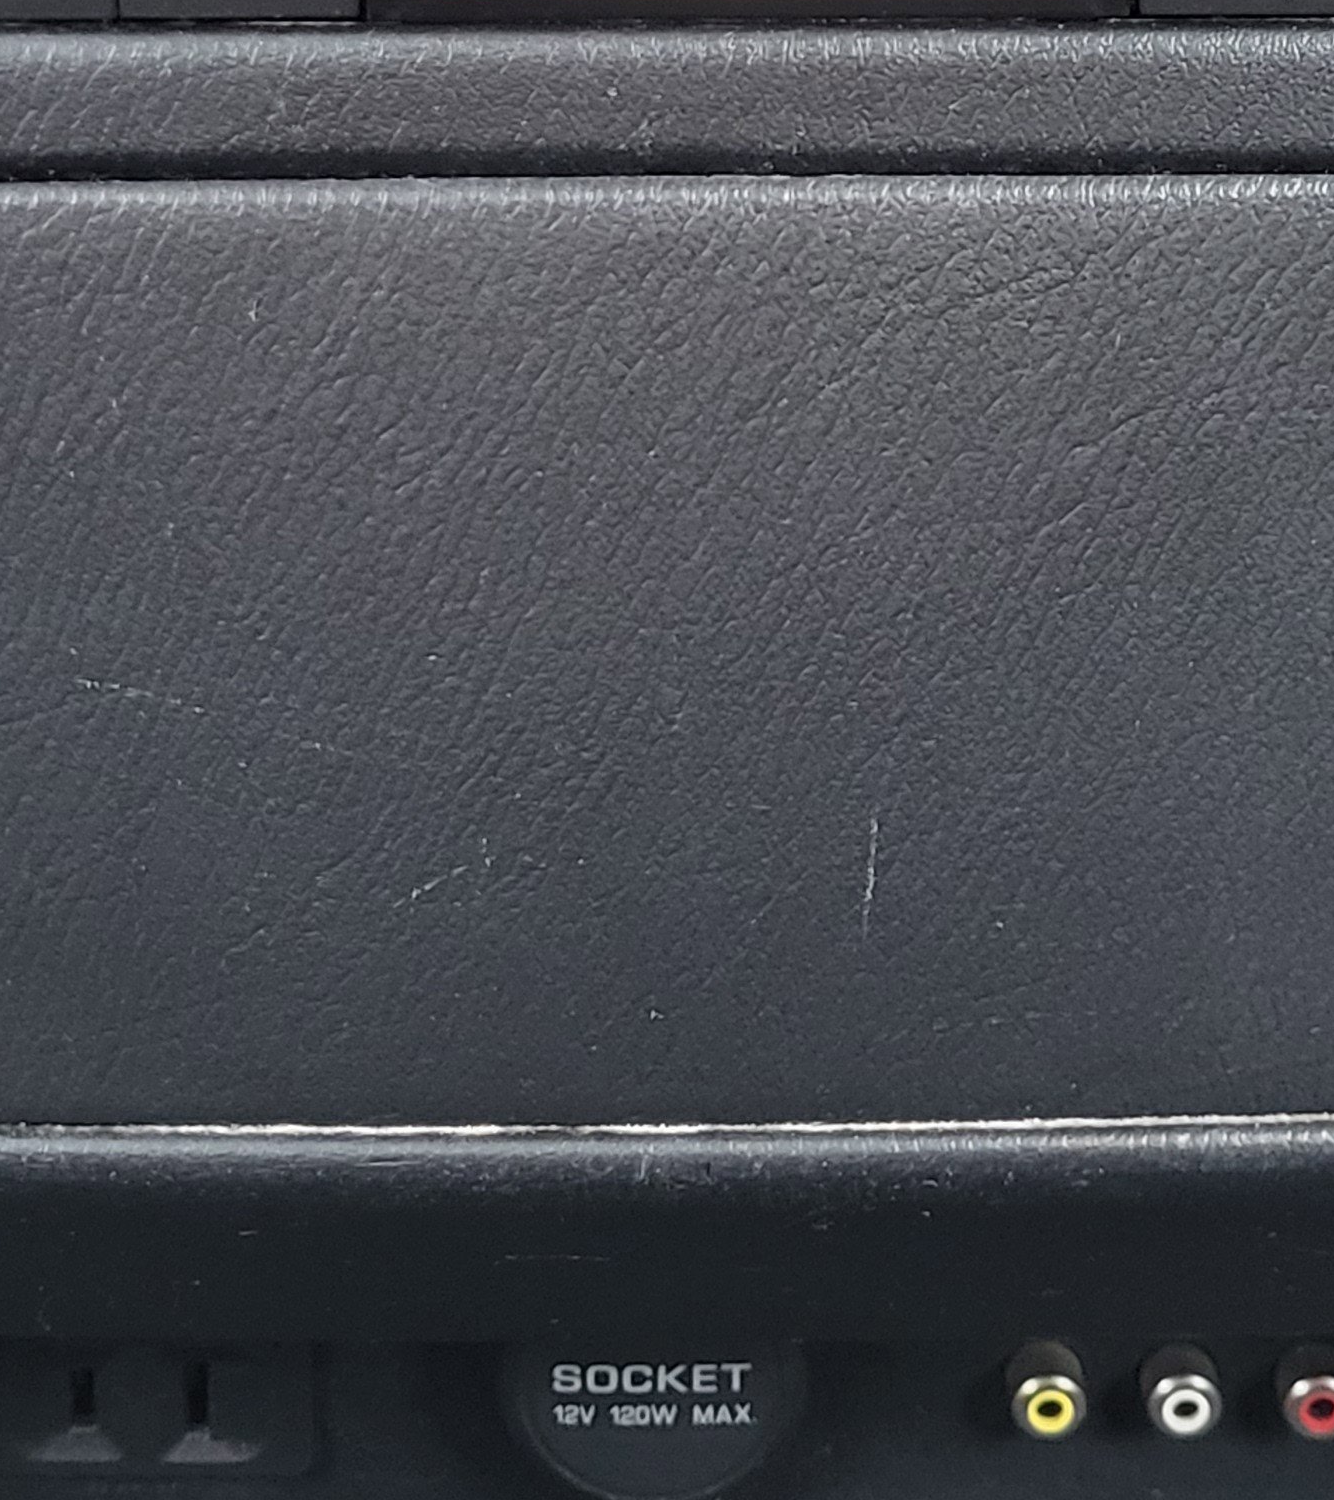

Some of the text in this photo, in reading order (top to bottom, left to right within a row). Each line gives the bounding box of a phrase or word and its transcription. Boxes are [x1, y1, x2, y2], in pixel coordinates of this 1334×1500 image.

[551, 1362, 753, 1394] SOCKET
[552, 1403, 597, 1426] 12V
[609, 1403, 678, 1427] 120W
